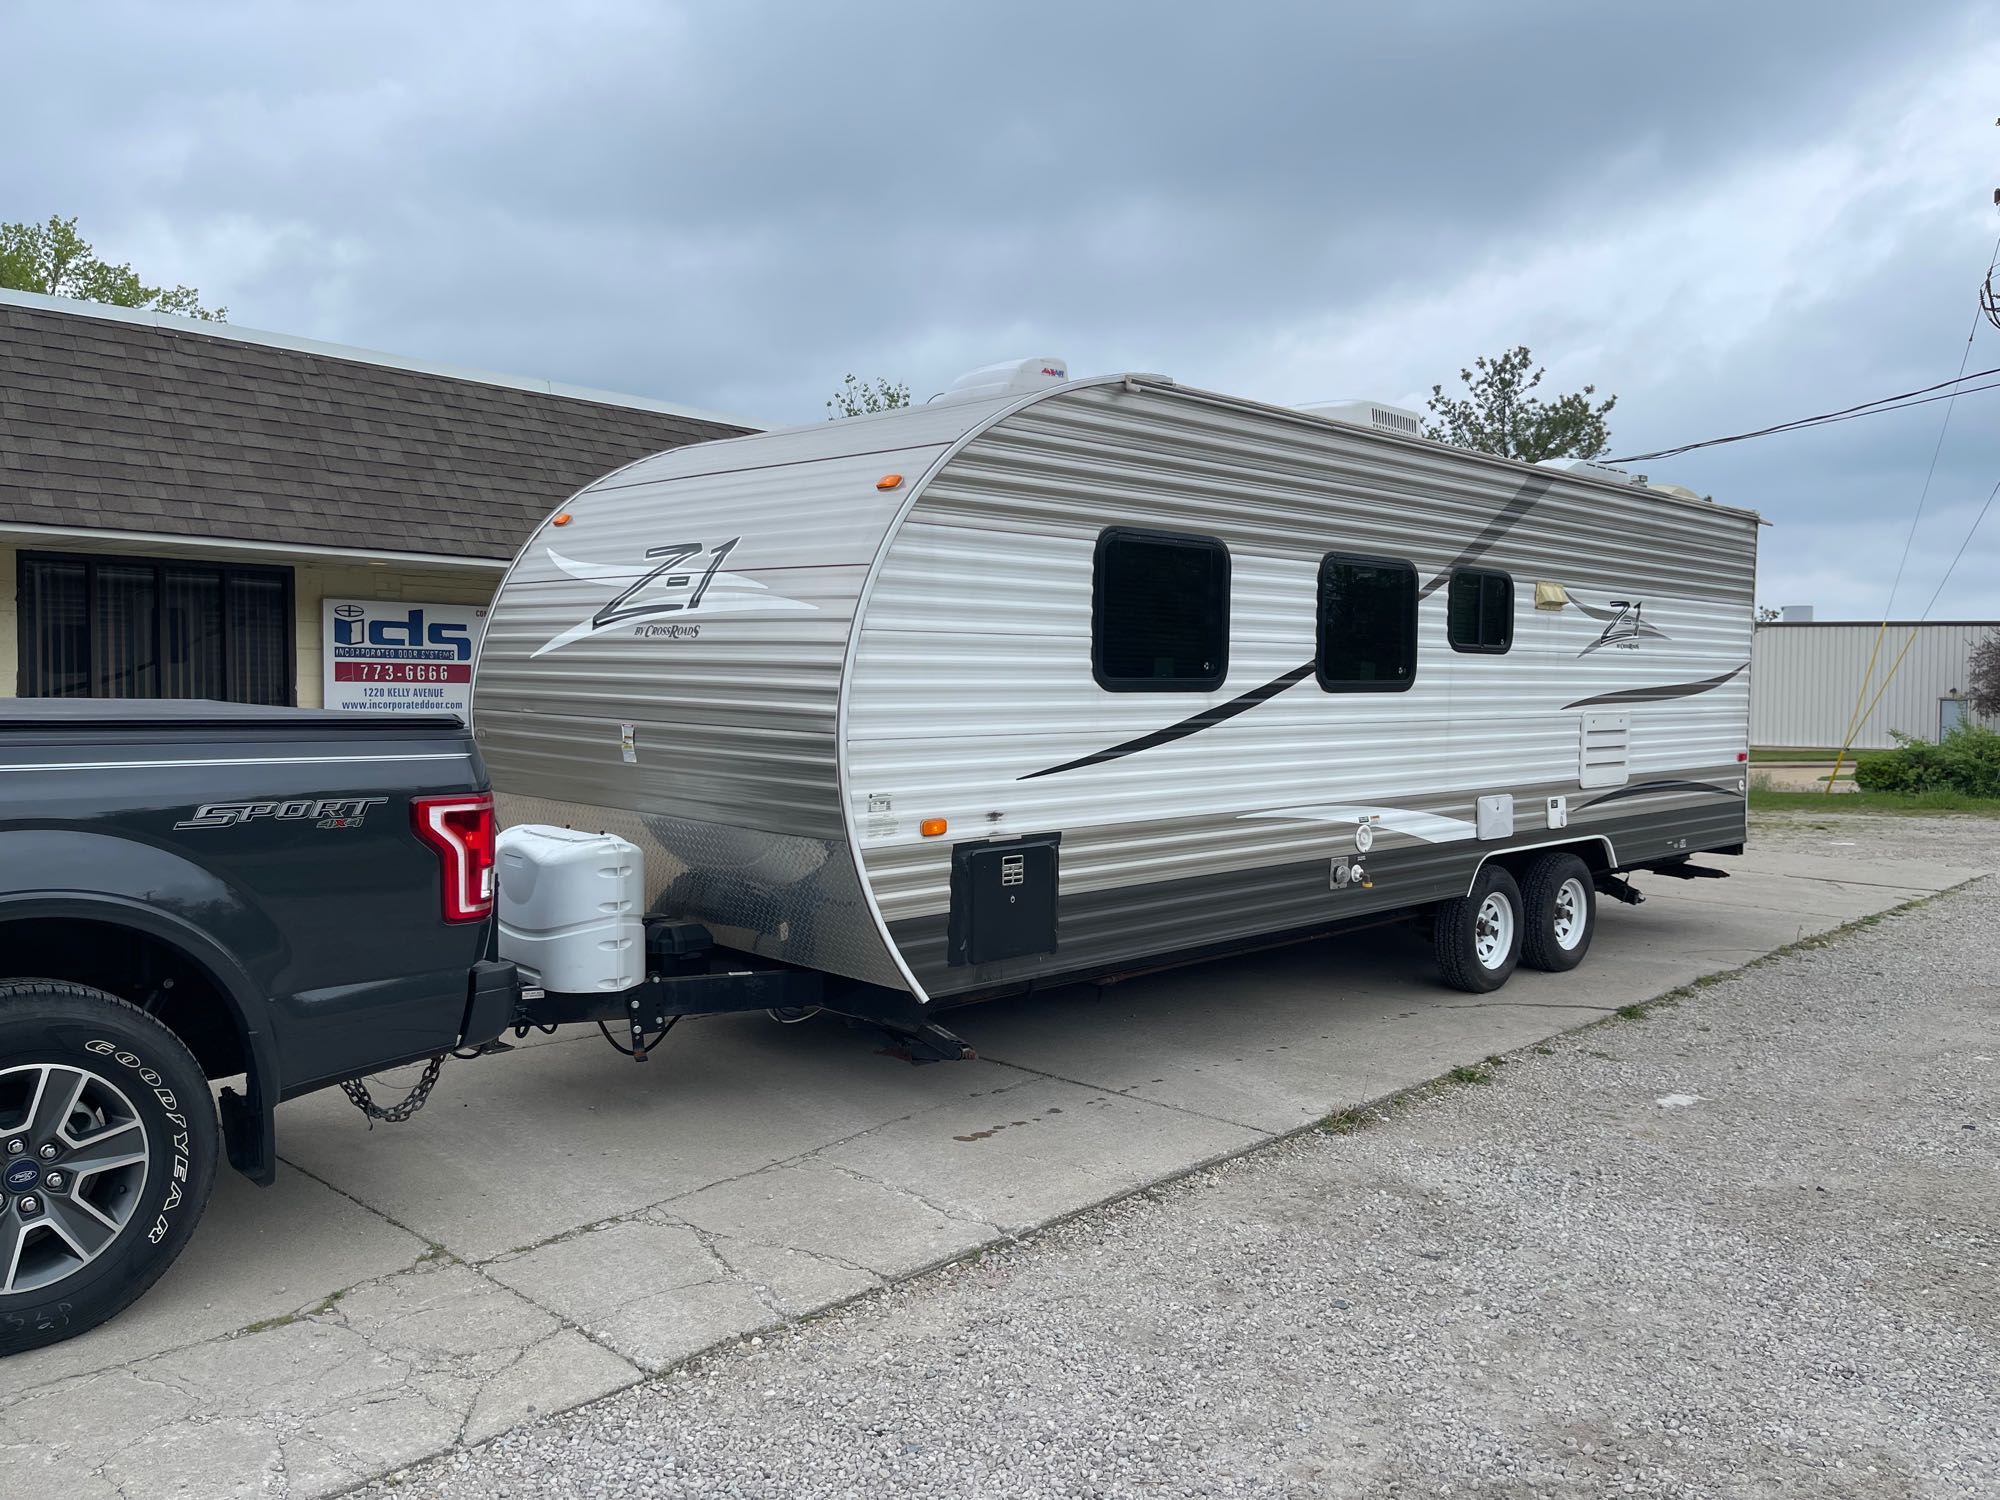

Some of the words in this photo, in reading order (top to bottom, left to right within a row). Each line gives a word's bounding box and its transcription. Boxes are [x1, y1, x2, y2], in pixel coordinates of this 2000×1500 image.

[592, 535, 742, 630] Z-1
[634, 626, 645, 636] BY
[1600, 601, 1642, 645] Z-1
[335, 647, 395, 658] INCORPORATED
[398, 649, 418, 659] DOOR
[421, 650, 455, 660] SYSTEMS
[360, 664, 448, 681] 773-6666
[363, 687, 385, 698] 1220
[387, 688, 410, 698] KELLY
[413, 688, 444, 698] AVENUE
[342, 699, 463, 711] www.incorporateddoor.com
[173, 796, 389, 831] SPORT
[84, 1039, 190, 1244] GOODYEAR
